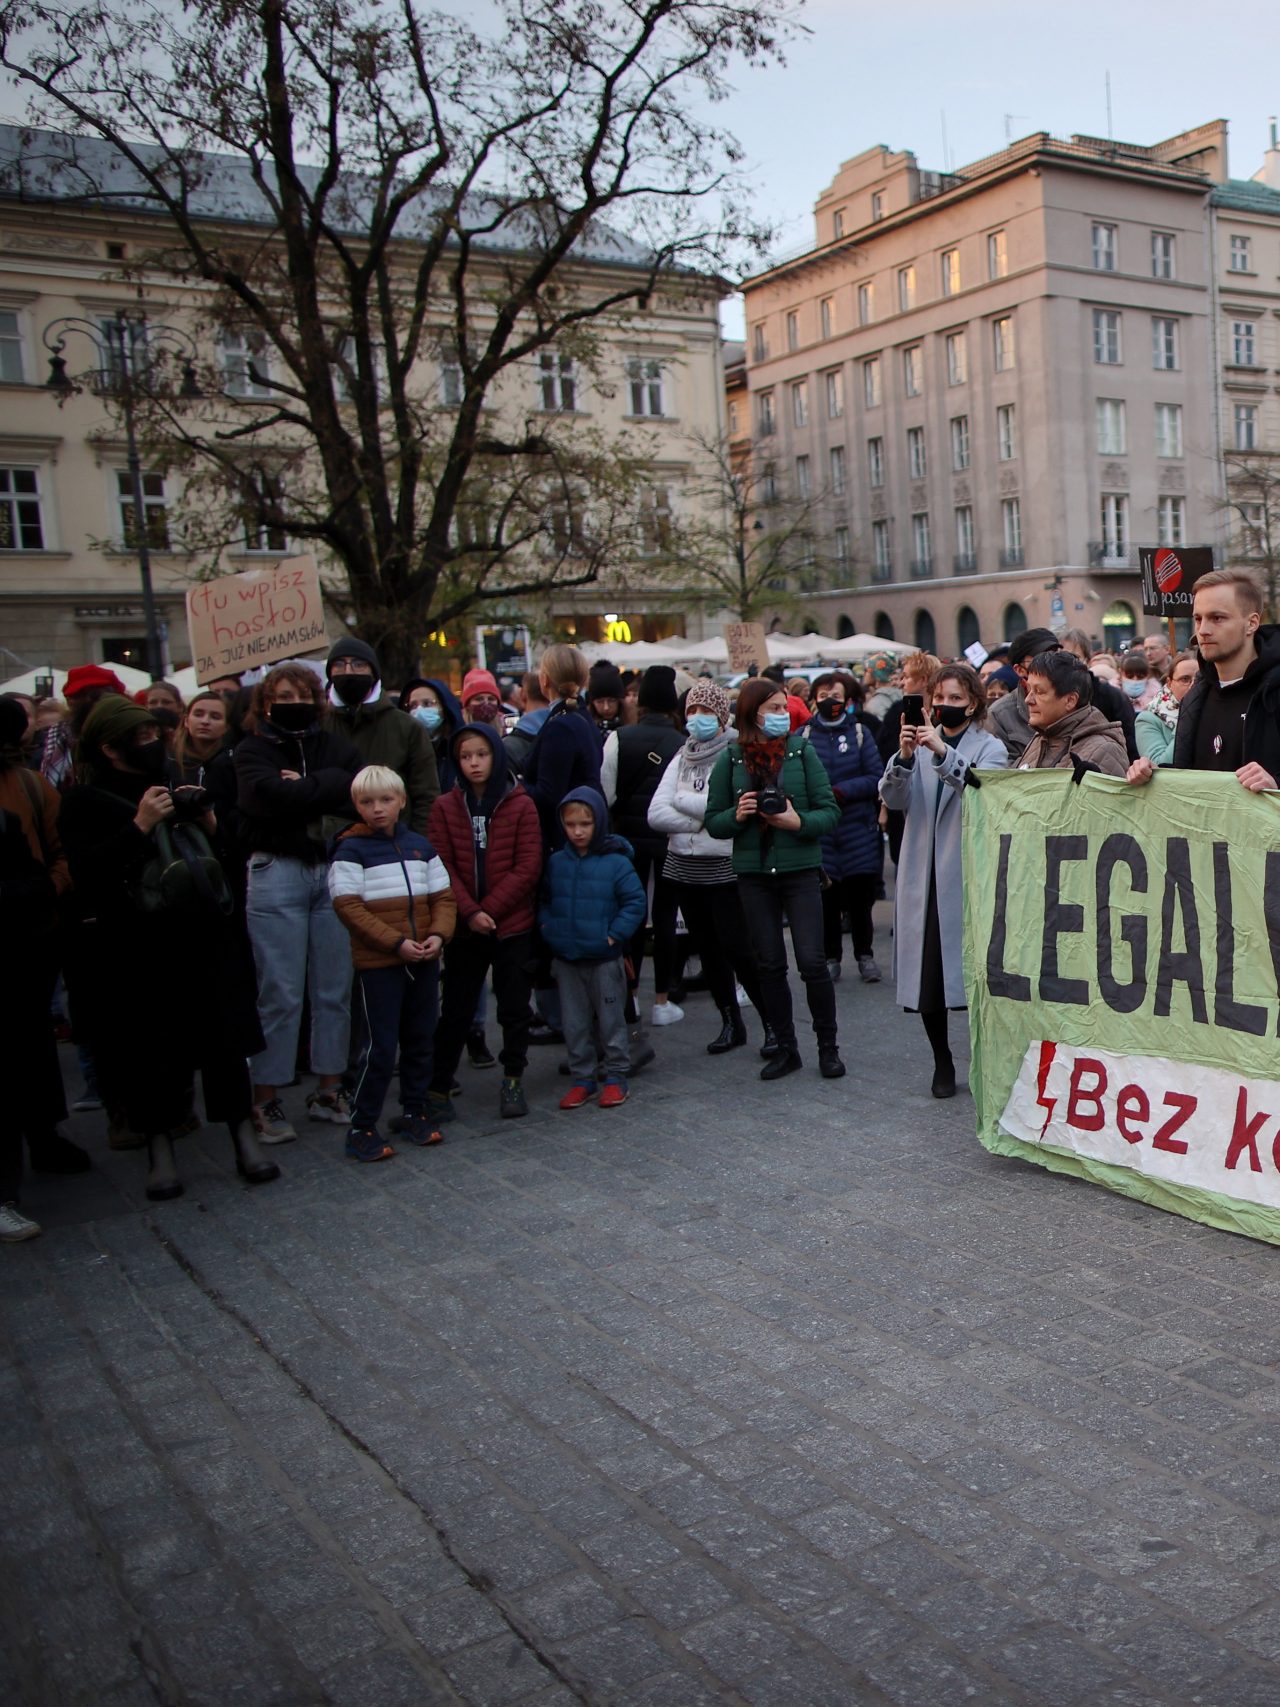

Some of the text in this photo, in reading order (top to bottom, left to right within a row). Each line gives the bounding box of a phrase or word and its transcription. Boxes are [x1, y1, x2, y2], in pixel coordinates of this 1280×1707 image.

[239, 570, 305, 612] wpisz
[197, 656, 215, 674] JA
[221, 642, 245, 665] JUŻ
[300, 621, 325, 642] SŁÓW
[1065, 1057, 1198, 1155] Bez
